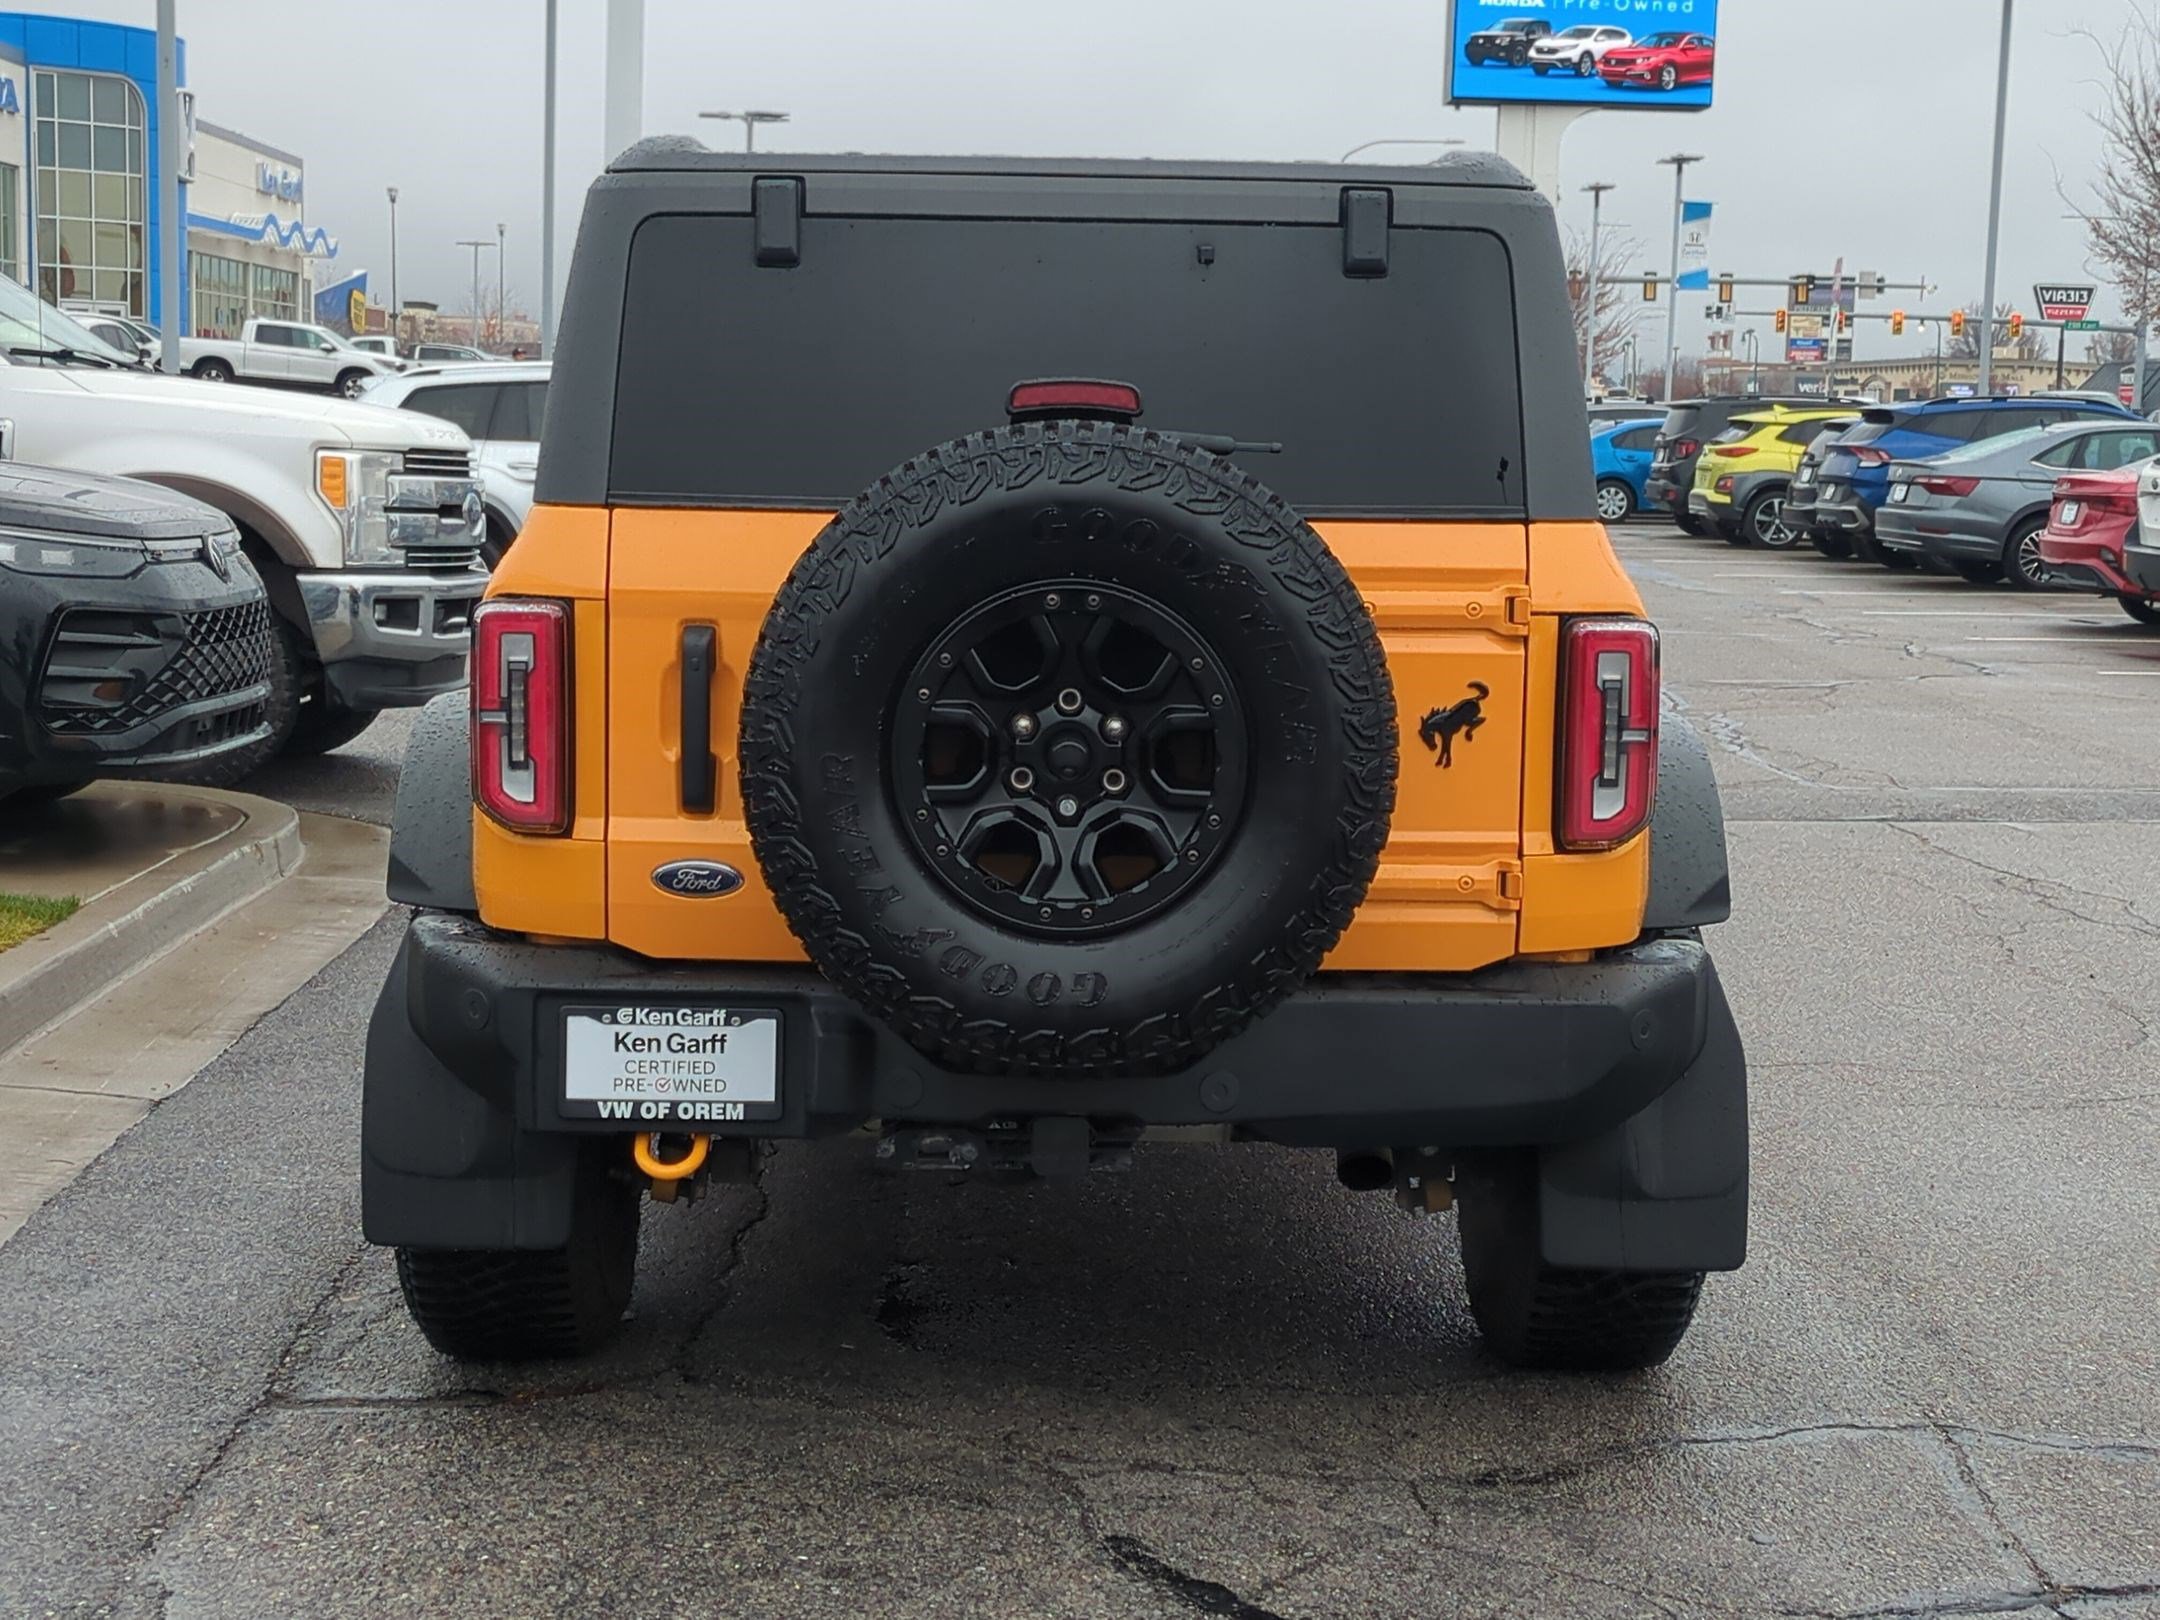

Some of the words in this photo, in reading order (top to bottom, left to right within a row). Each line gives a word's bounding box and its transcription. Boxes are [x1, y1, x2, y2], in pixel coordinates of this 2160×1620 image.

[1563, 0, 1694, 13] Pre-Owned
[672, 868, 722, 890] Ford
[635, 1008, 674, 1025] Ken
[676, 1008, 726, 1026] Garff
[614, 1031, 661, 1053] Ken
[667, 1033, 727, 1054] Garff
[624, 1060, 716, 1075] CERTIFIED
[613, 1077, 727, 1094] PRE-OWNED
[597, 1101, 633, 1119] VW
[640, 1102, 671, 1120] OF
[677, 1102, 744, 1121] OREM
